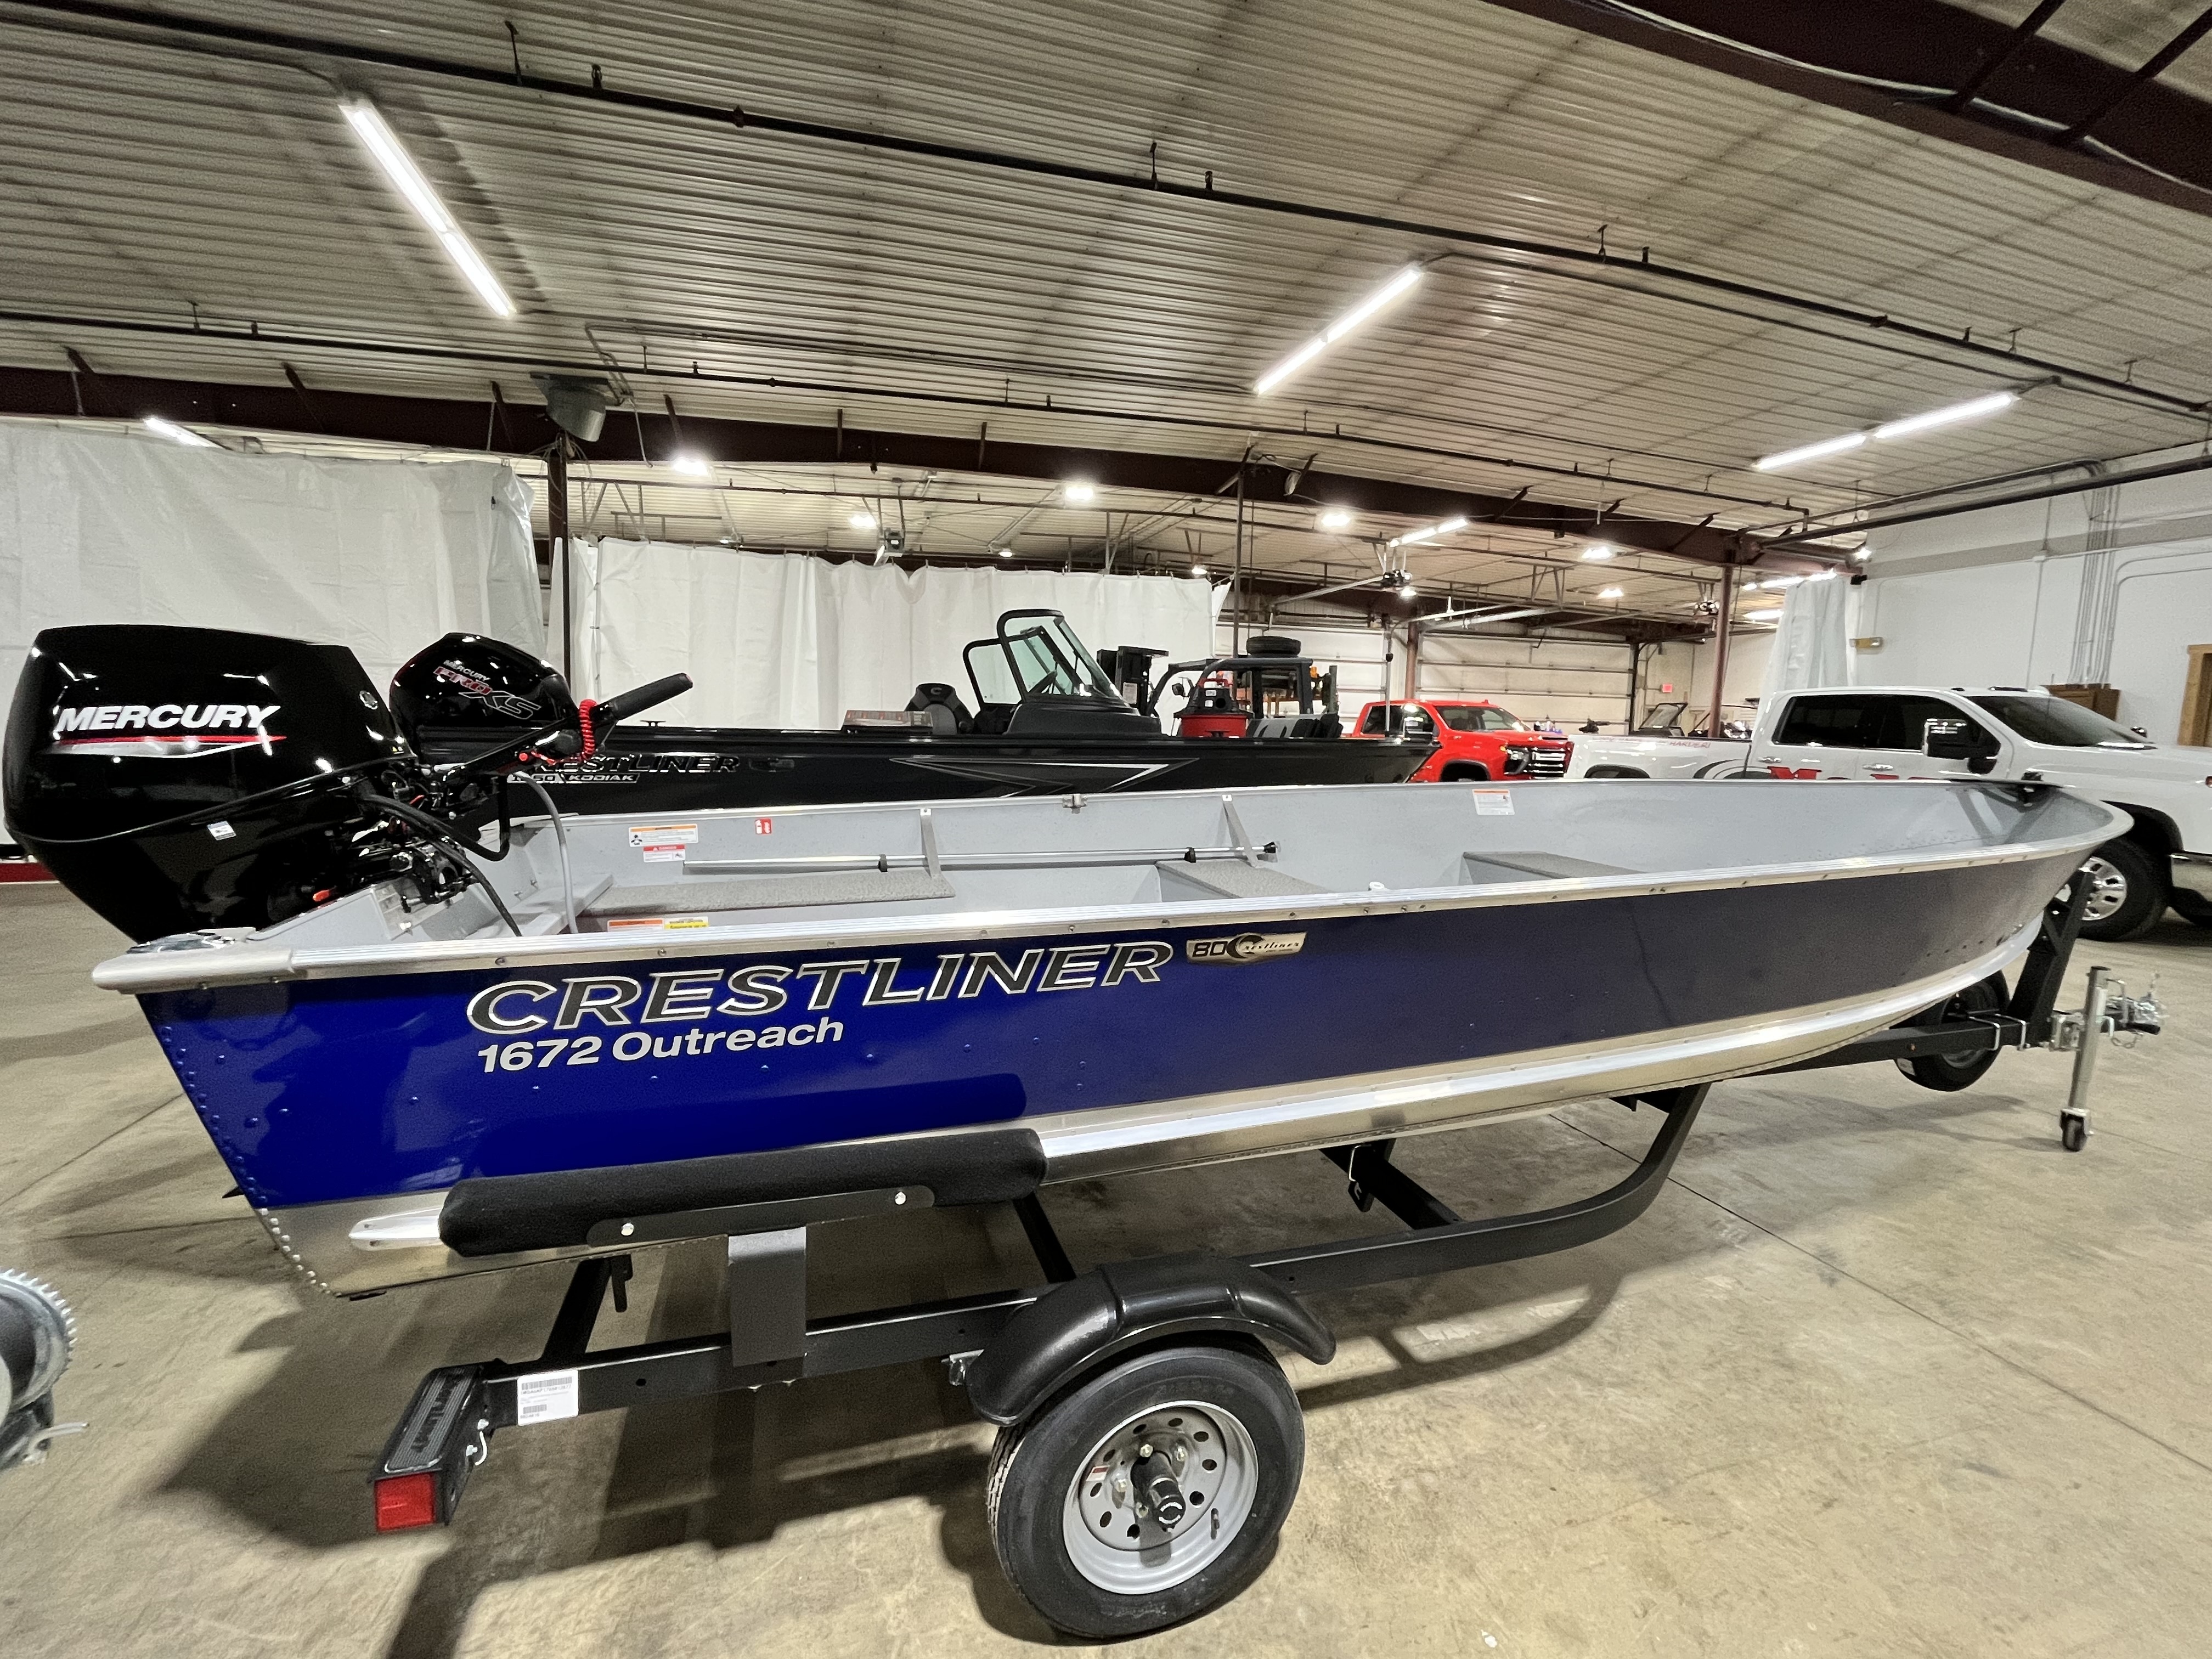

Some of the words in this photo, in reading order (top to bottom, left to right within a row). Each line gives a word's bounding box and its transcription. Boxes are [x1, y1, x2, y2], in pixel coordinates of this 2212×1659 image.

[56, 704, 280, 732] MERCURY
[1192, 941, 1228, 957] 80
[467, 941, 1173, 1035] CRESTLINER
[478, 1036, 602, 1073] 1672
[613, 1017, 844, 1058] Outreach
